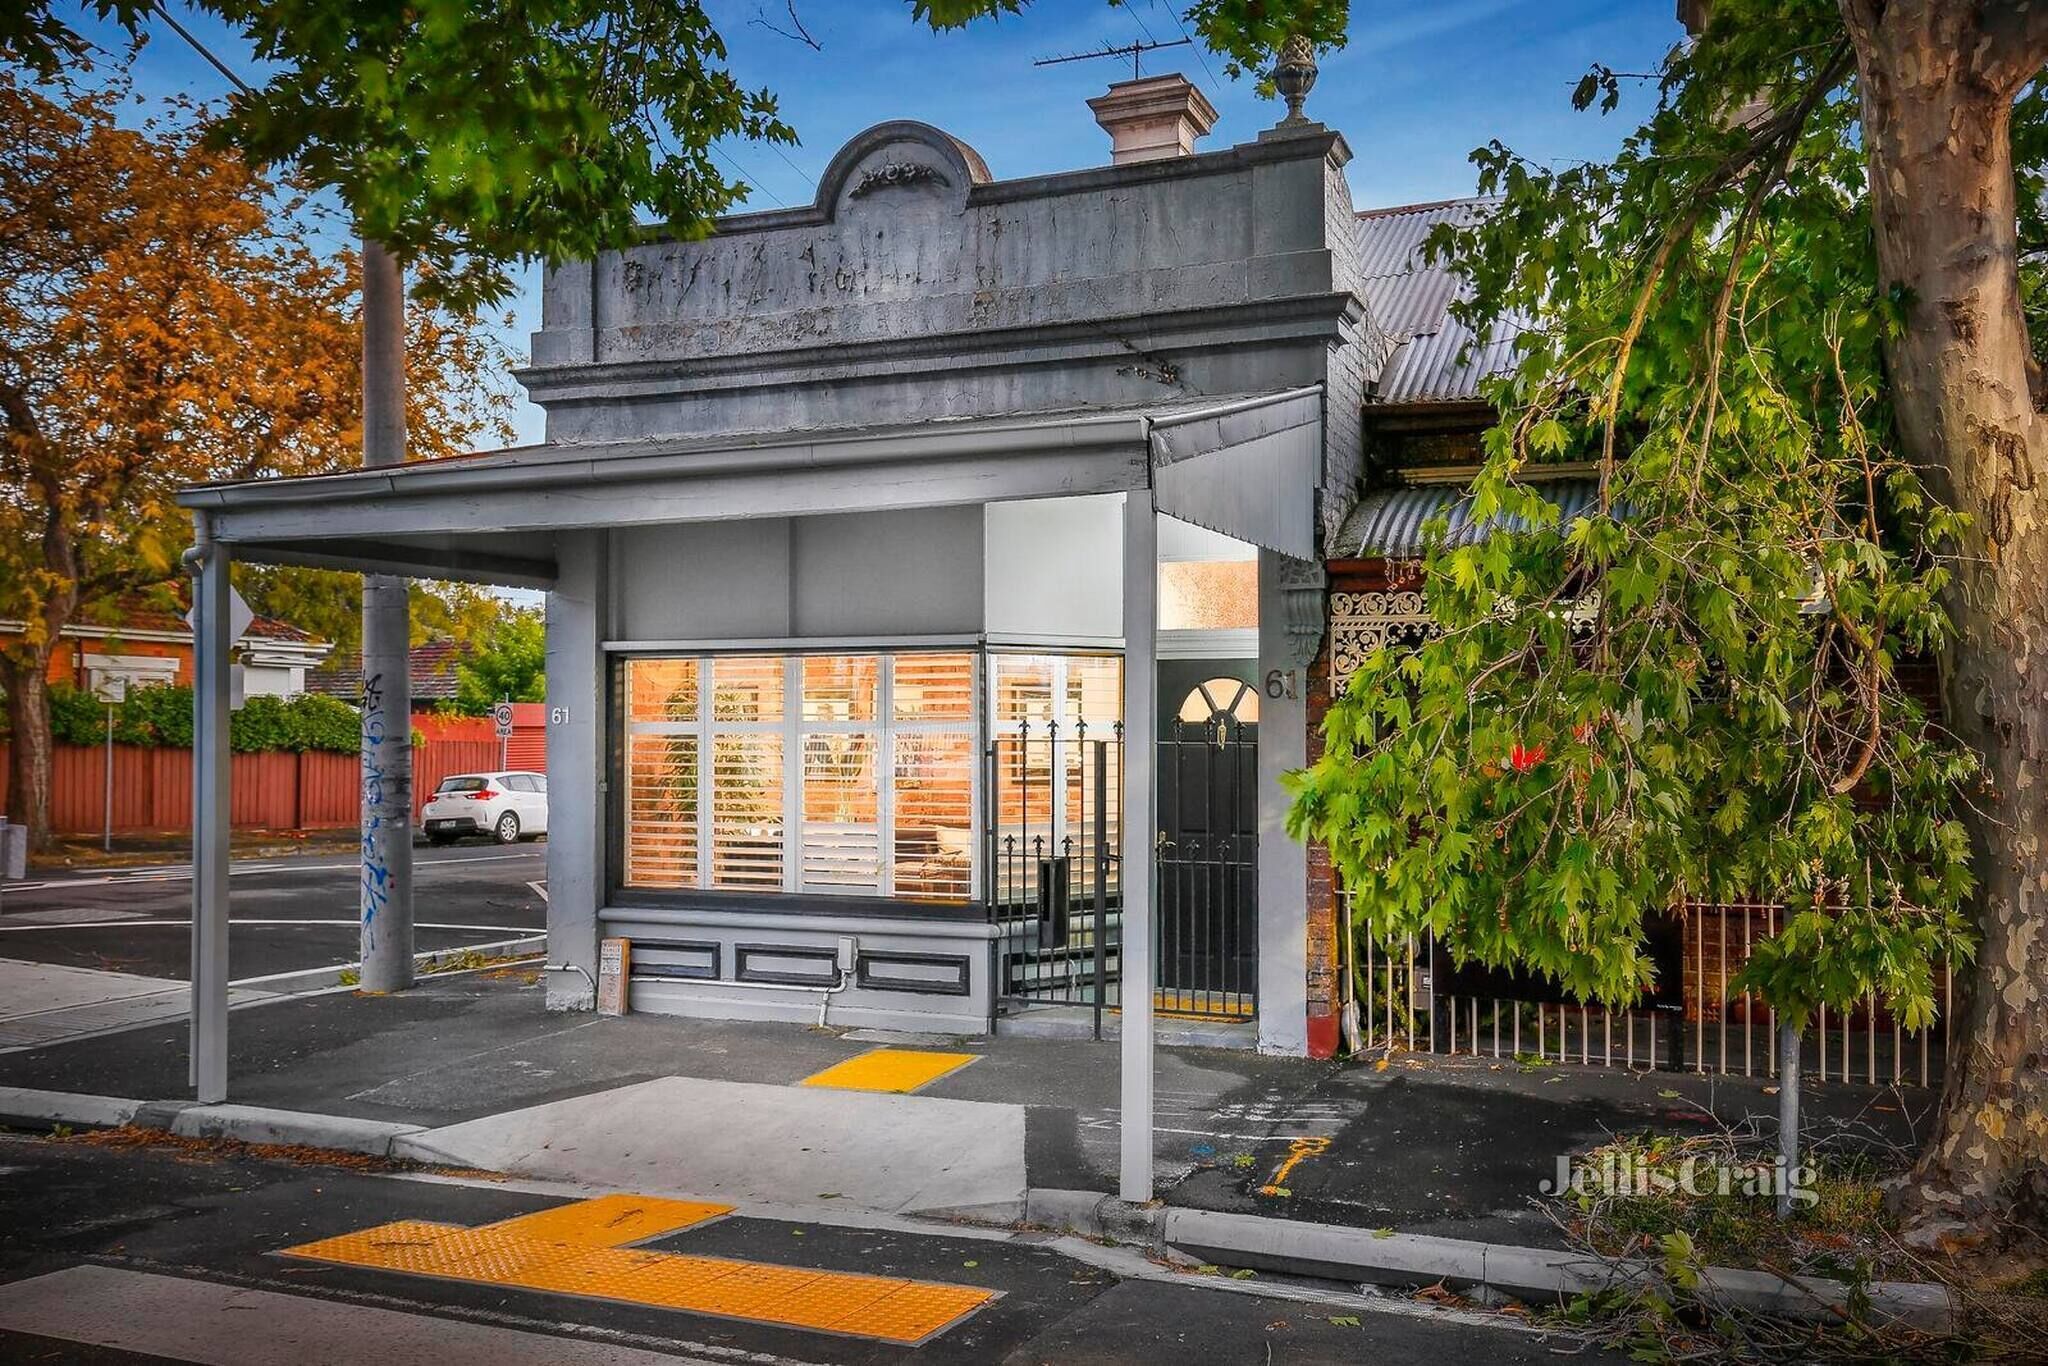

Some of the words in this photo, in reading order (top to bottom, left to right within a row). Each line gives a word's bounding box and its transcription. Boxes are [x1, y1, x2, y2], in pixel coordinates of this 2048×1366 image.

[1265, 669, 1298, 699] 61
[499, 711, 510, 720] 40
[552, 707, 570, 724] 61
[497, 727, 512, 735] AREA
